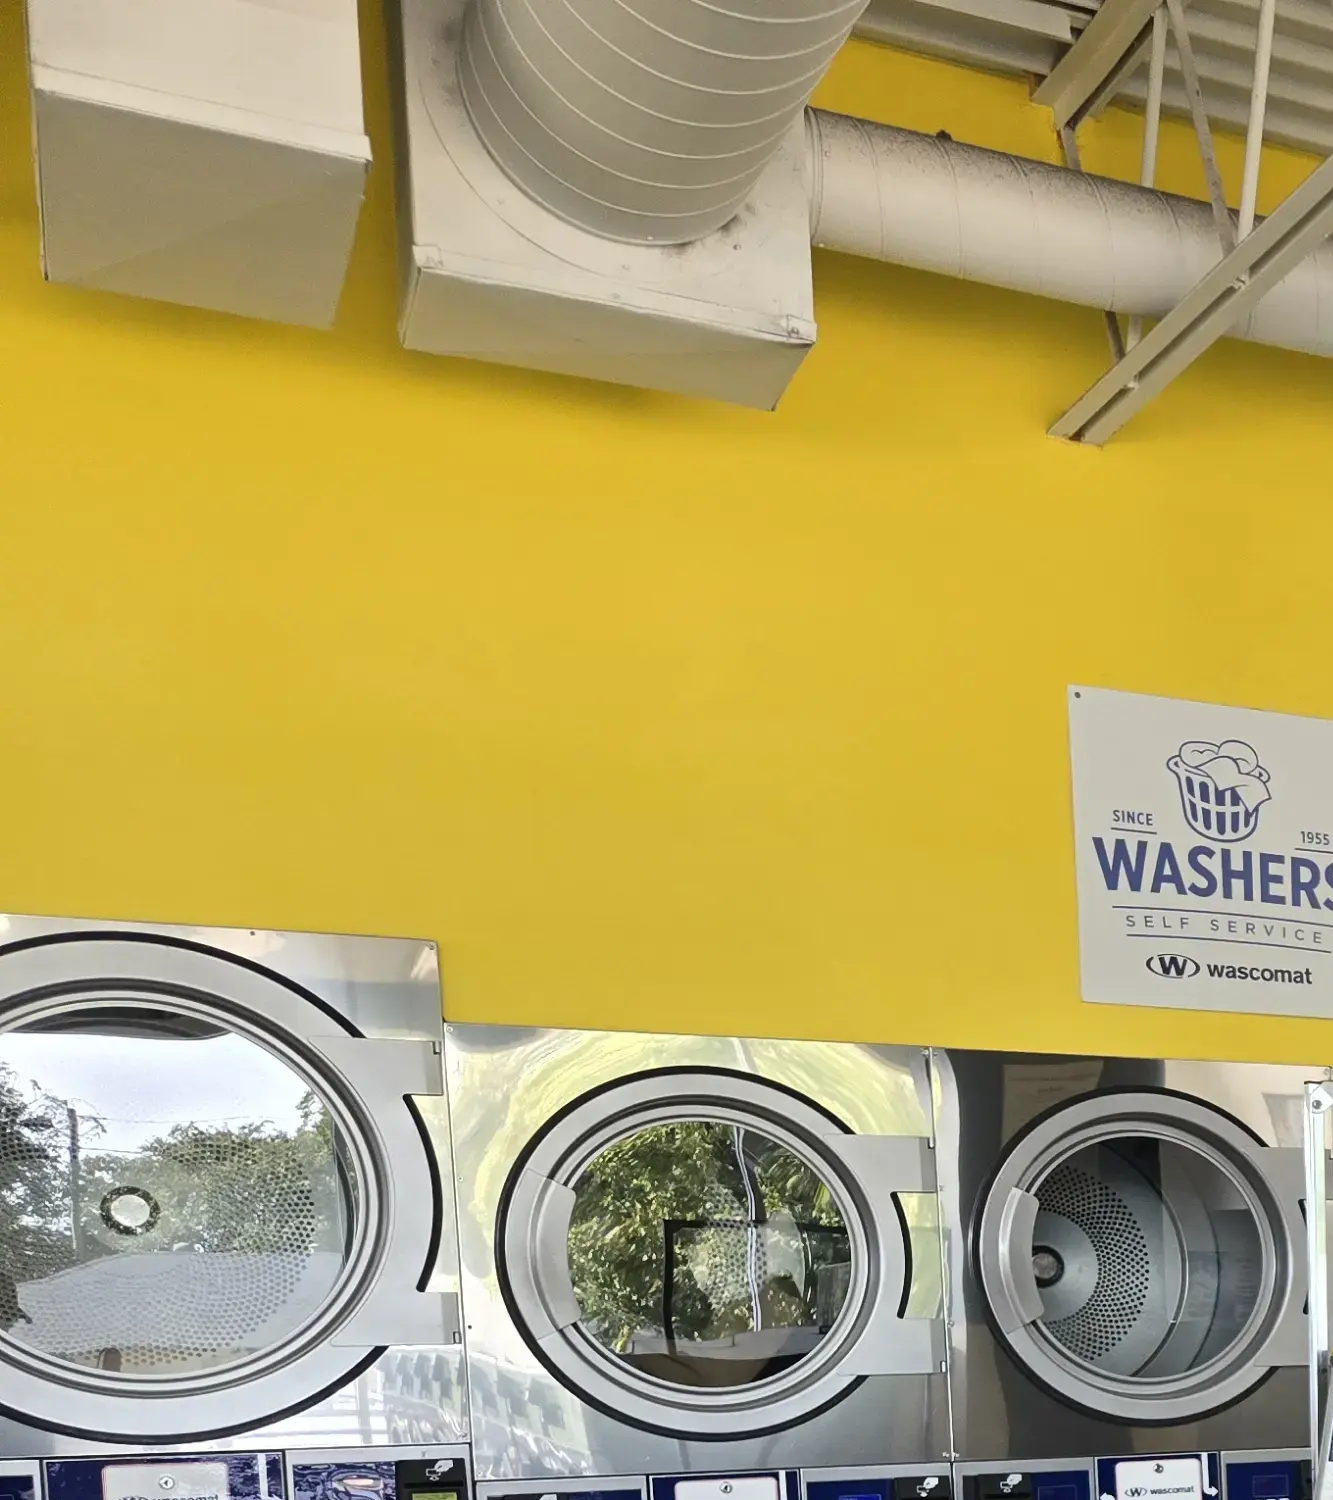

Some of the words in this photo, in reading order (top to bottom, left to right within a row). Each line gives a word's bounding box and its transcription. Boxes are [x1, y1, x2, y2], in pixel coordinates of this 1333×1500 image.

[1113, 810, 1153, 826] SINCE
[1300, 831, 1330, 846] 1955
[1126, 915, 1190, 929] SELF
[1210, 919, 1323, 944] SERVICE
[1207, 963, 1313, 984] wascomat
[1150, 1485, 1194, 1494] wascomat
